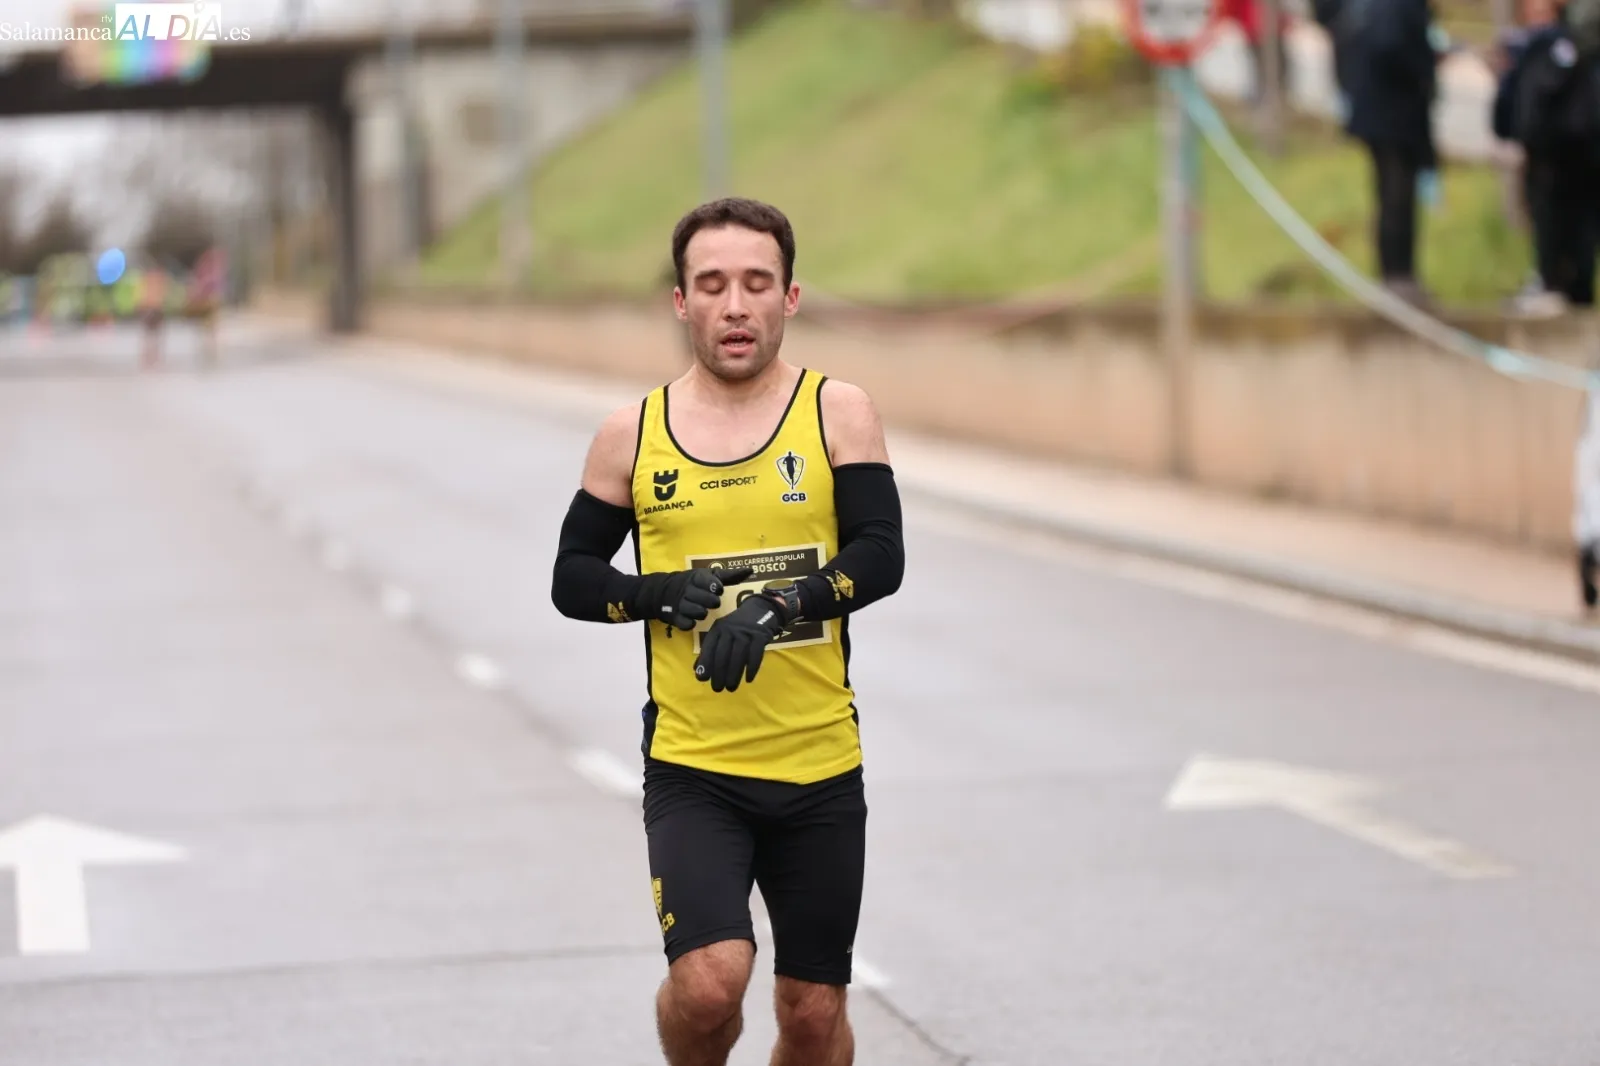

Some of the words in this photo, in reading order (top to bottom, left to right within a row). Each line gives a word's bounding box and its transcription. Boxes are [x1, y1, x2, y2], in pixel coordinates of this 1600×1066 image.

[699, 480, 719, 490] CCI
[721, 475, 758, 488] SPORT
[782, 492, 807, 502] GCB
[643, 500, 694, 515] BRAGANÇA
[744, 556, 774, 566] CARRERA
[774, 553, 805, 562] POPULAR
[752, 562, 787, 574] BOSCO
[662, 912, 676, 936] CB
